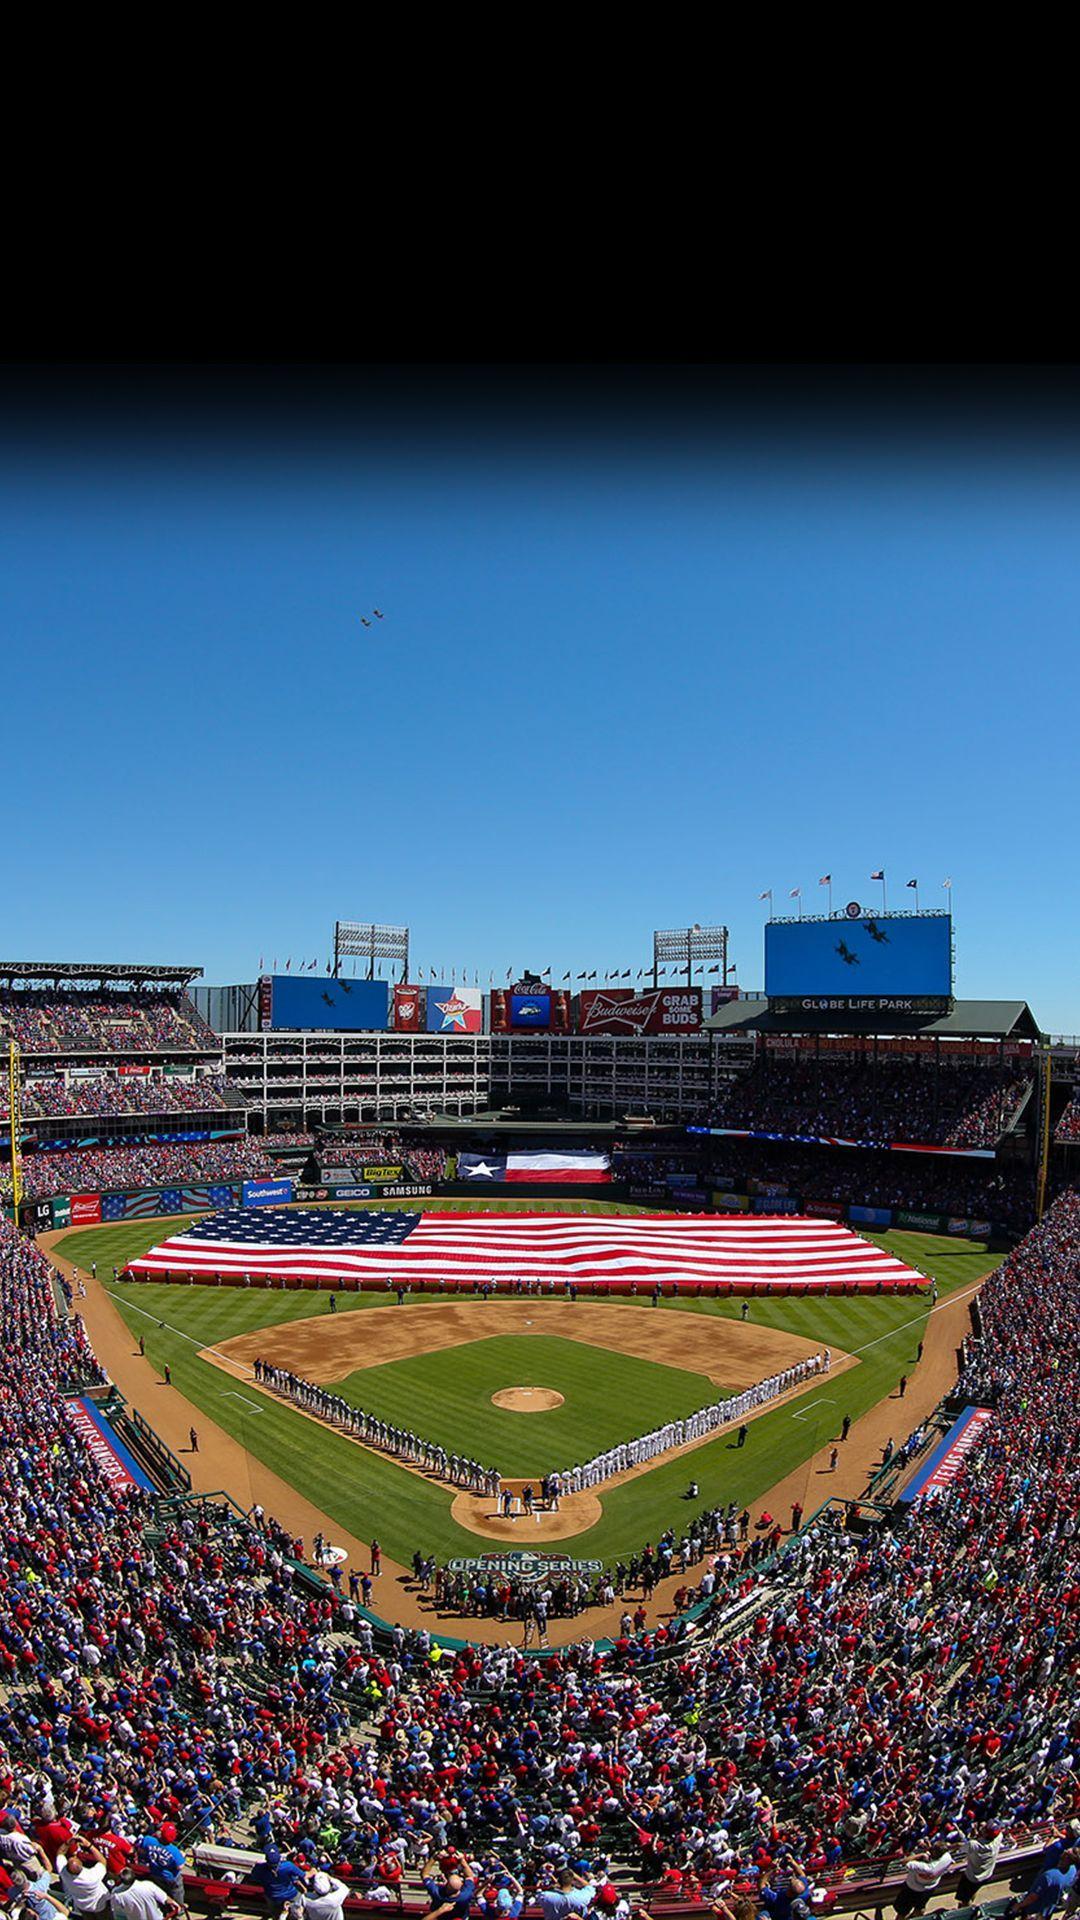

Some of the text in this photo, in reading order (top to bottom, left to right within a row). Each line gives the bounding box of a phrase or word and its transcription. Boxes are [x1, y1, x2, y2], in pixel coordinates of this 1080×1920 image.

[662, 995, 698, 1006] GRAB
[802, 999, 912, 1009] GLOBE LIFE PARK
[585, 1002, 657, 1017] Budweiser
[662, 1013, 698, 1024] BUDS
[247, 1189, 283, 1198] Southwest
[336, 1188, 370, 1197] GEICO
[383, 1185, 432, 1196] SAMSUNG
[37, 1204, 50, 1217] LG
[907, 1215, 939, 1225] National
[452, 1559, 600, 1571] OPENING SERIES
